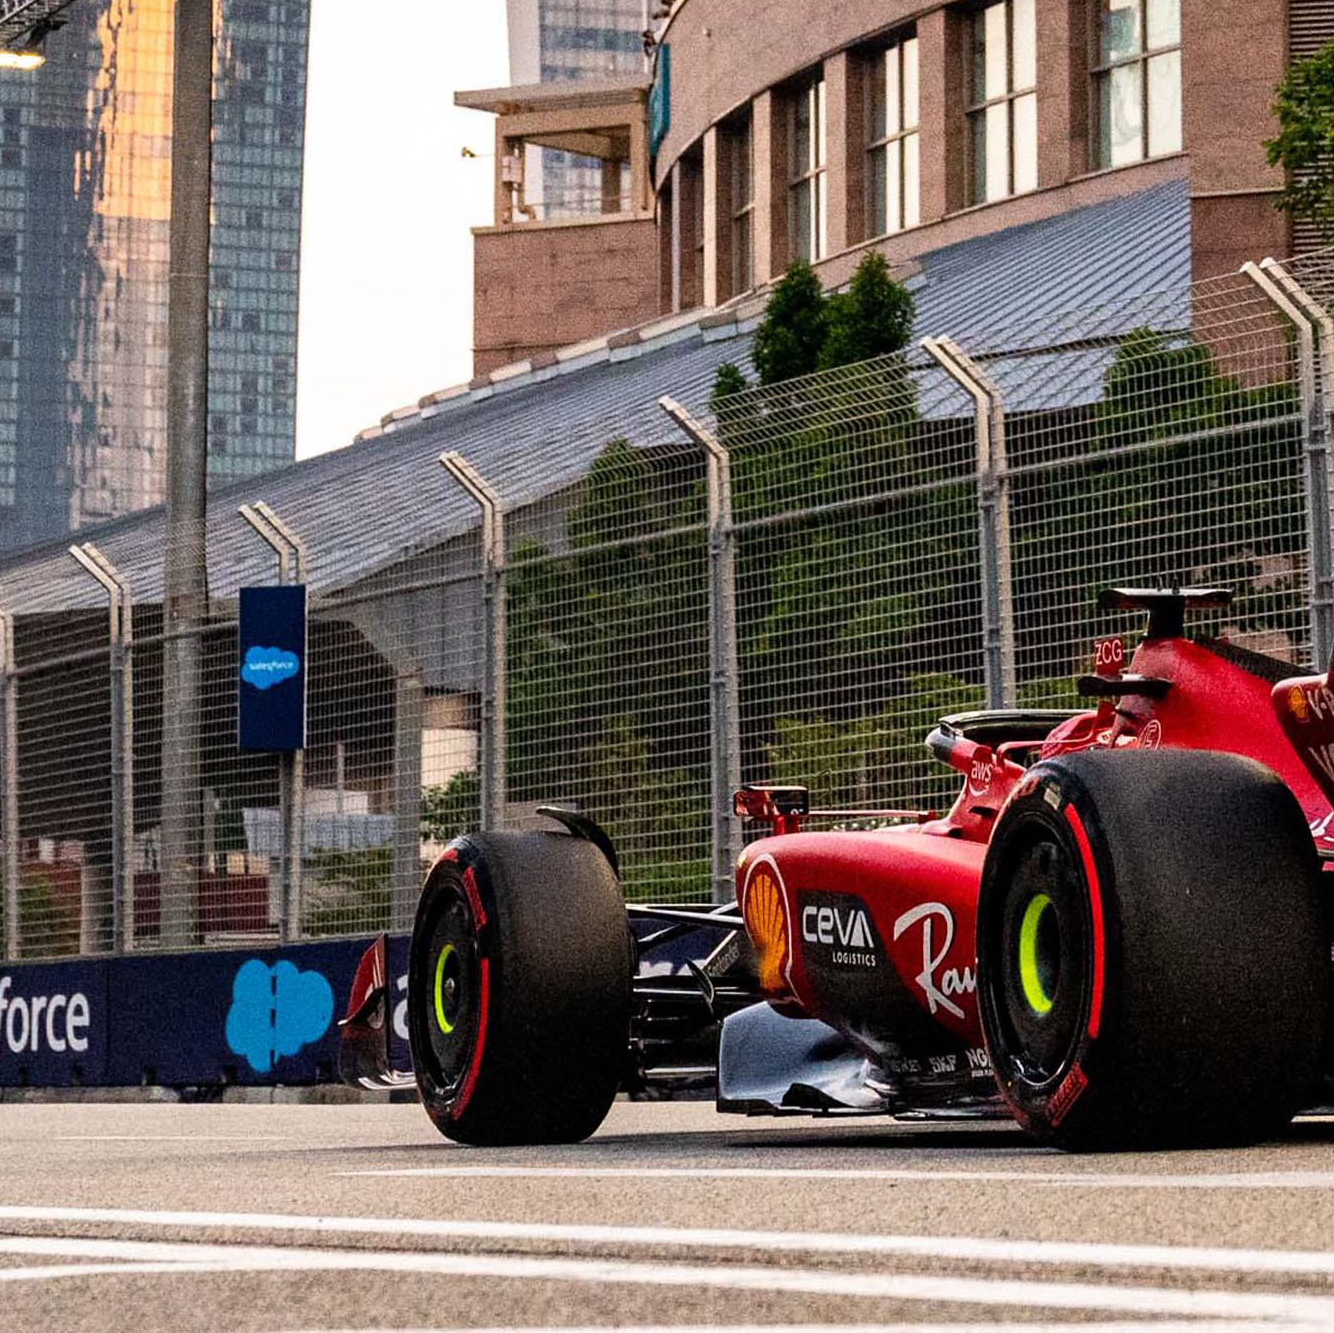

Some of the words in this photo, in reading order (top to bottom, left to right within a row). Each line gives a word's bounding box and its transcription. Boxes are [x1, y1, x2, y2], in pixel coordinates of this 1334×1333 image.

[1094, 639, 1123, 666] ZCG
[971, 760, 993, 782] aws
[832, 951, 876, 967] LOGISTICS
